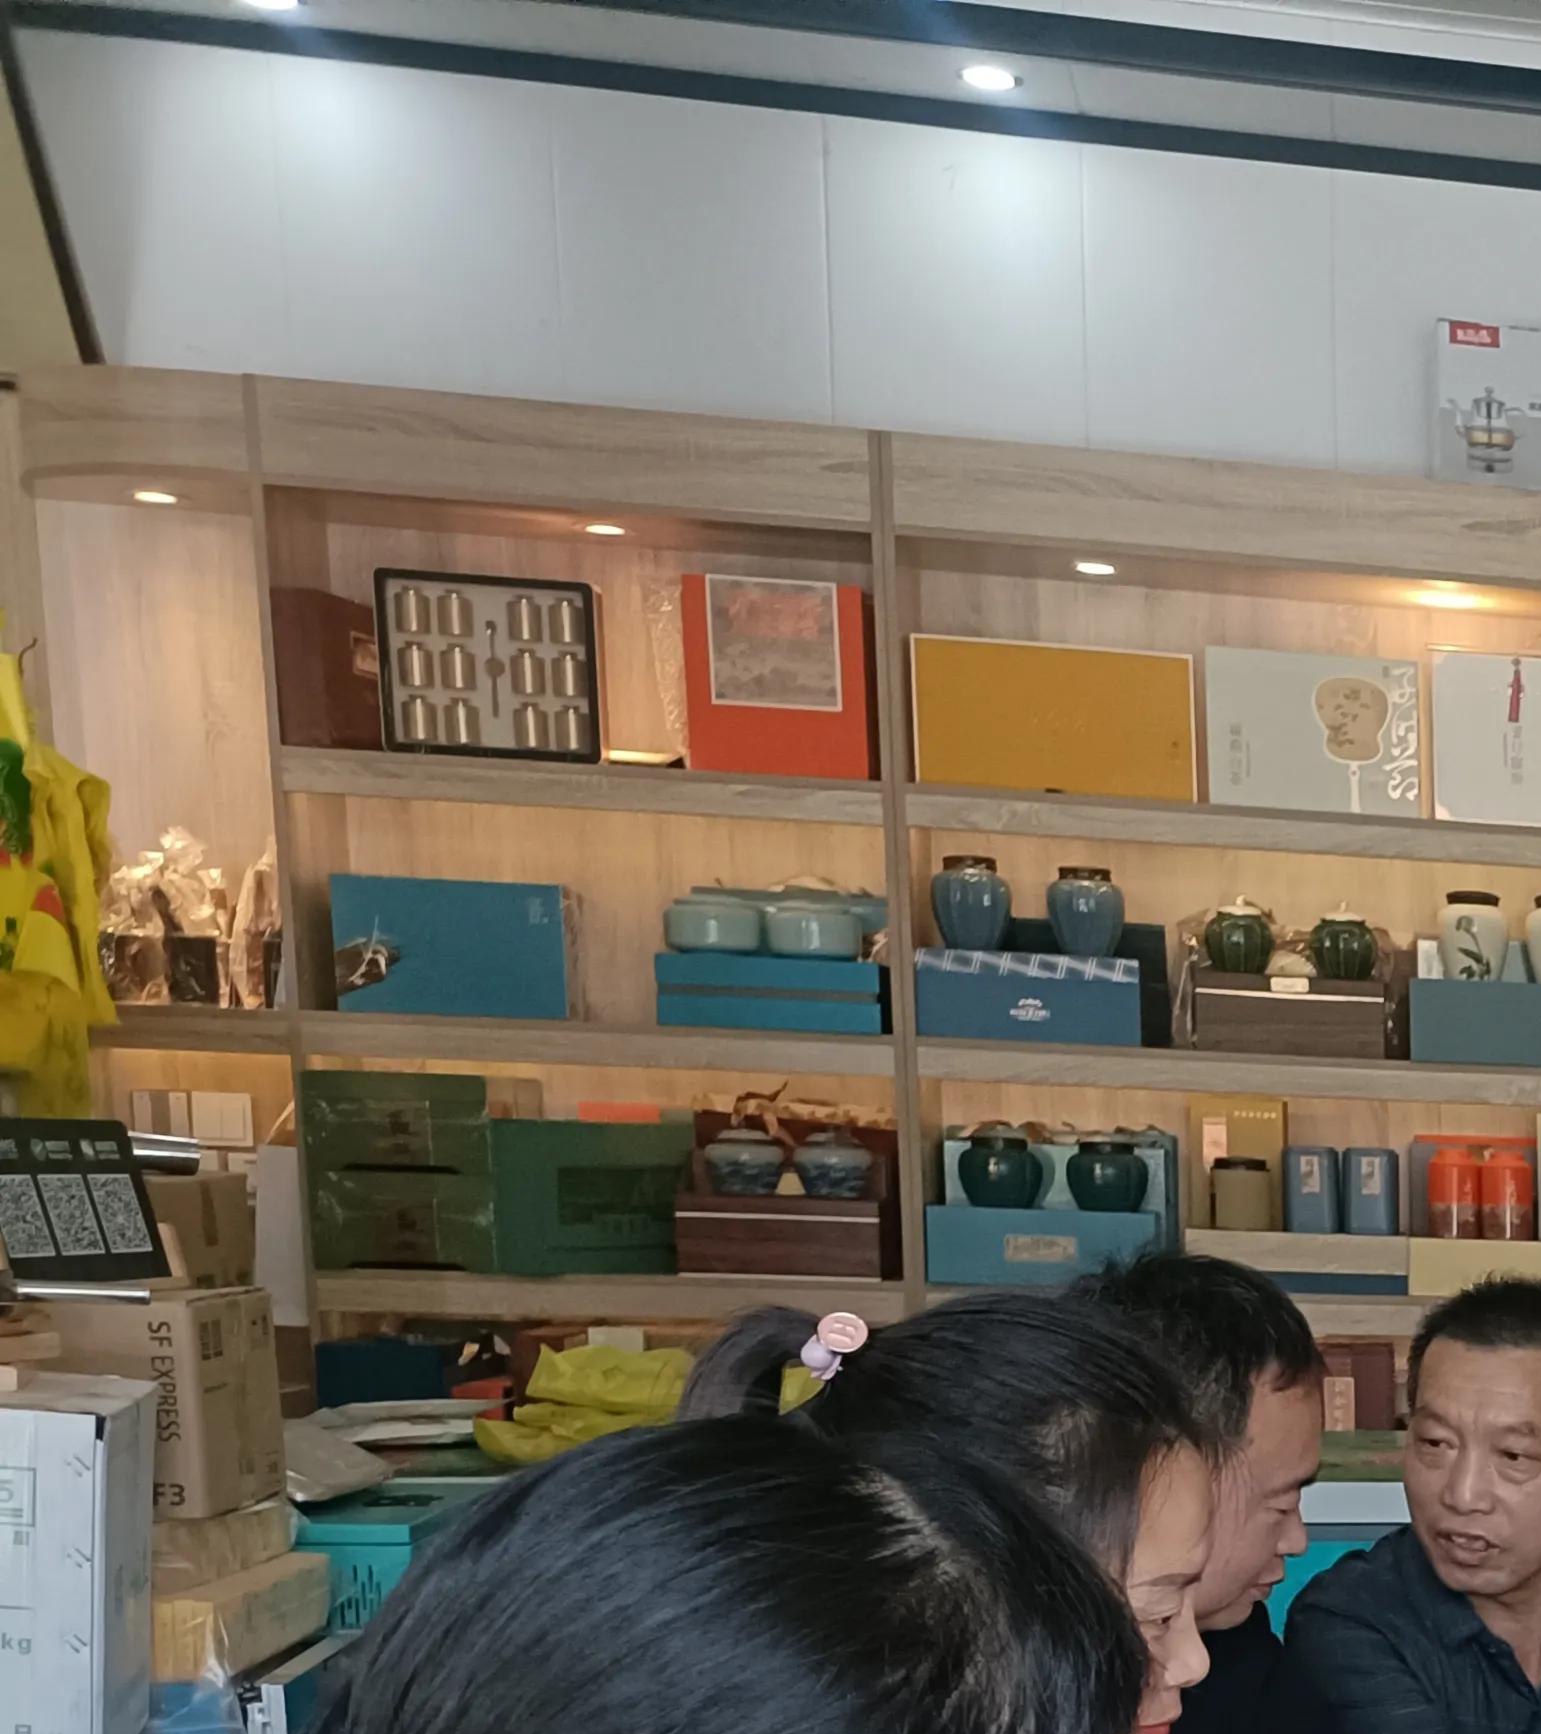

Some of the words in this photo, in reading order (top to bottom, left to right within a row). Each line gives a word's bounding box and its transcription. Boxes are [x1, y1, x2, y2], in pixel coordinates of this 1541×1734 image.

[147, 1320, 173, 1348] SF
[151, 1355, 182, 1443] EXPRESS
[1, 1632, 33, 1656] kg
